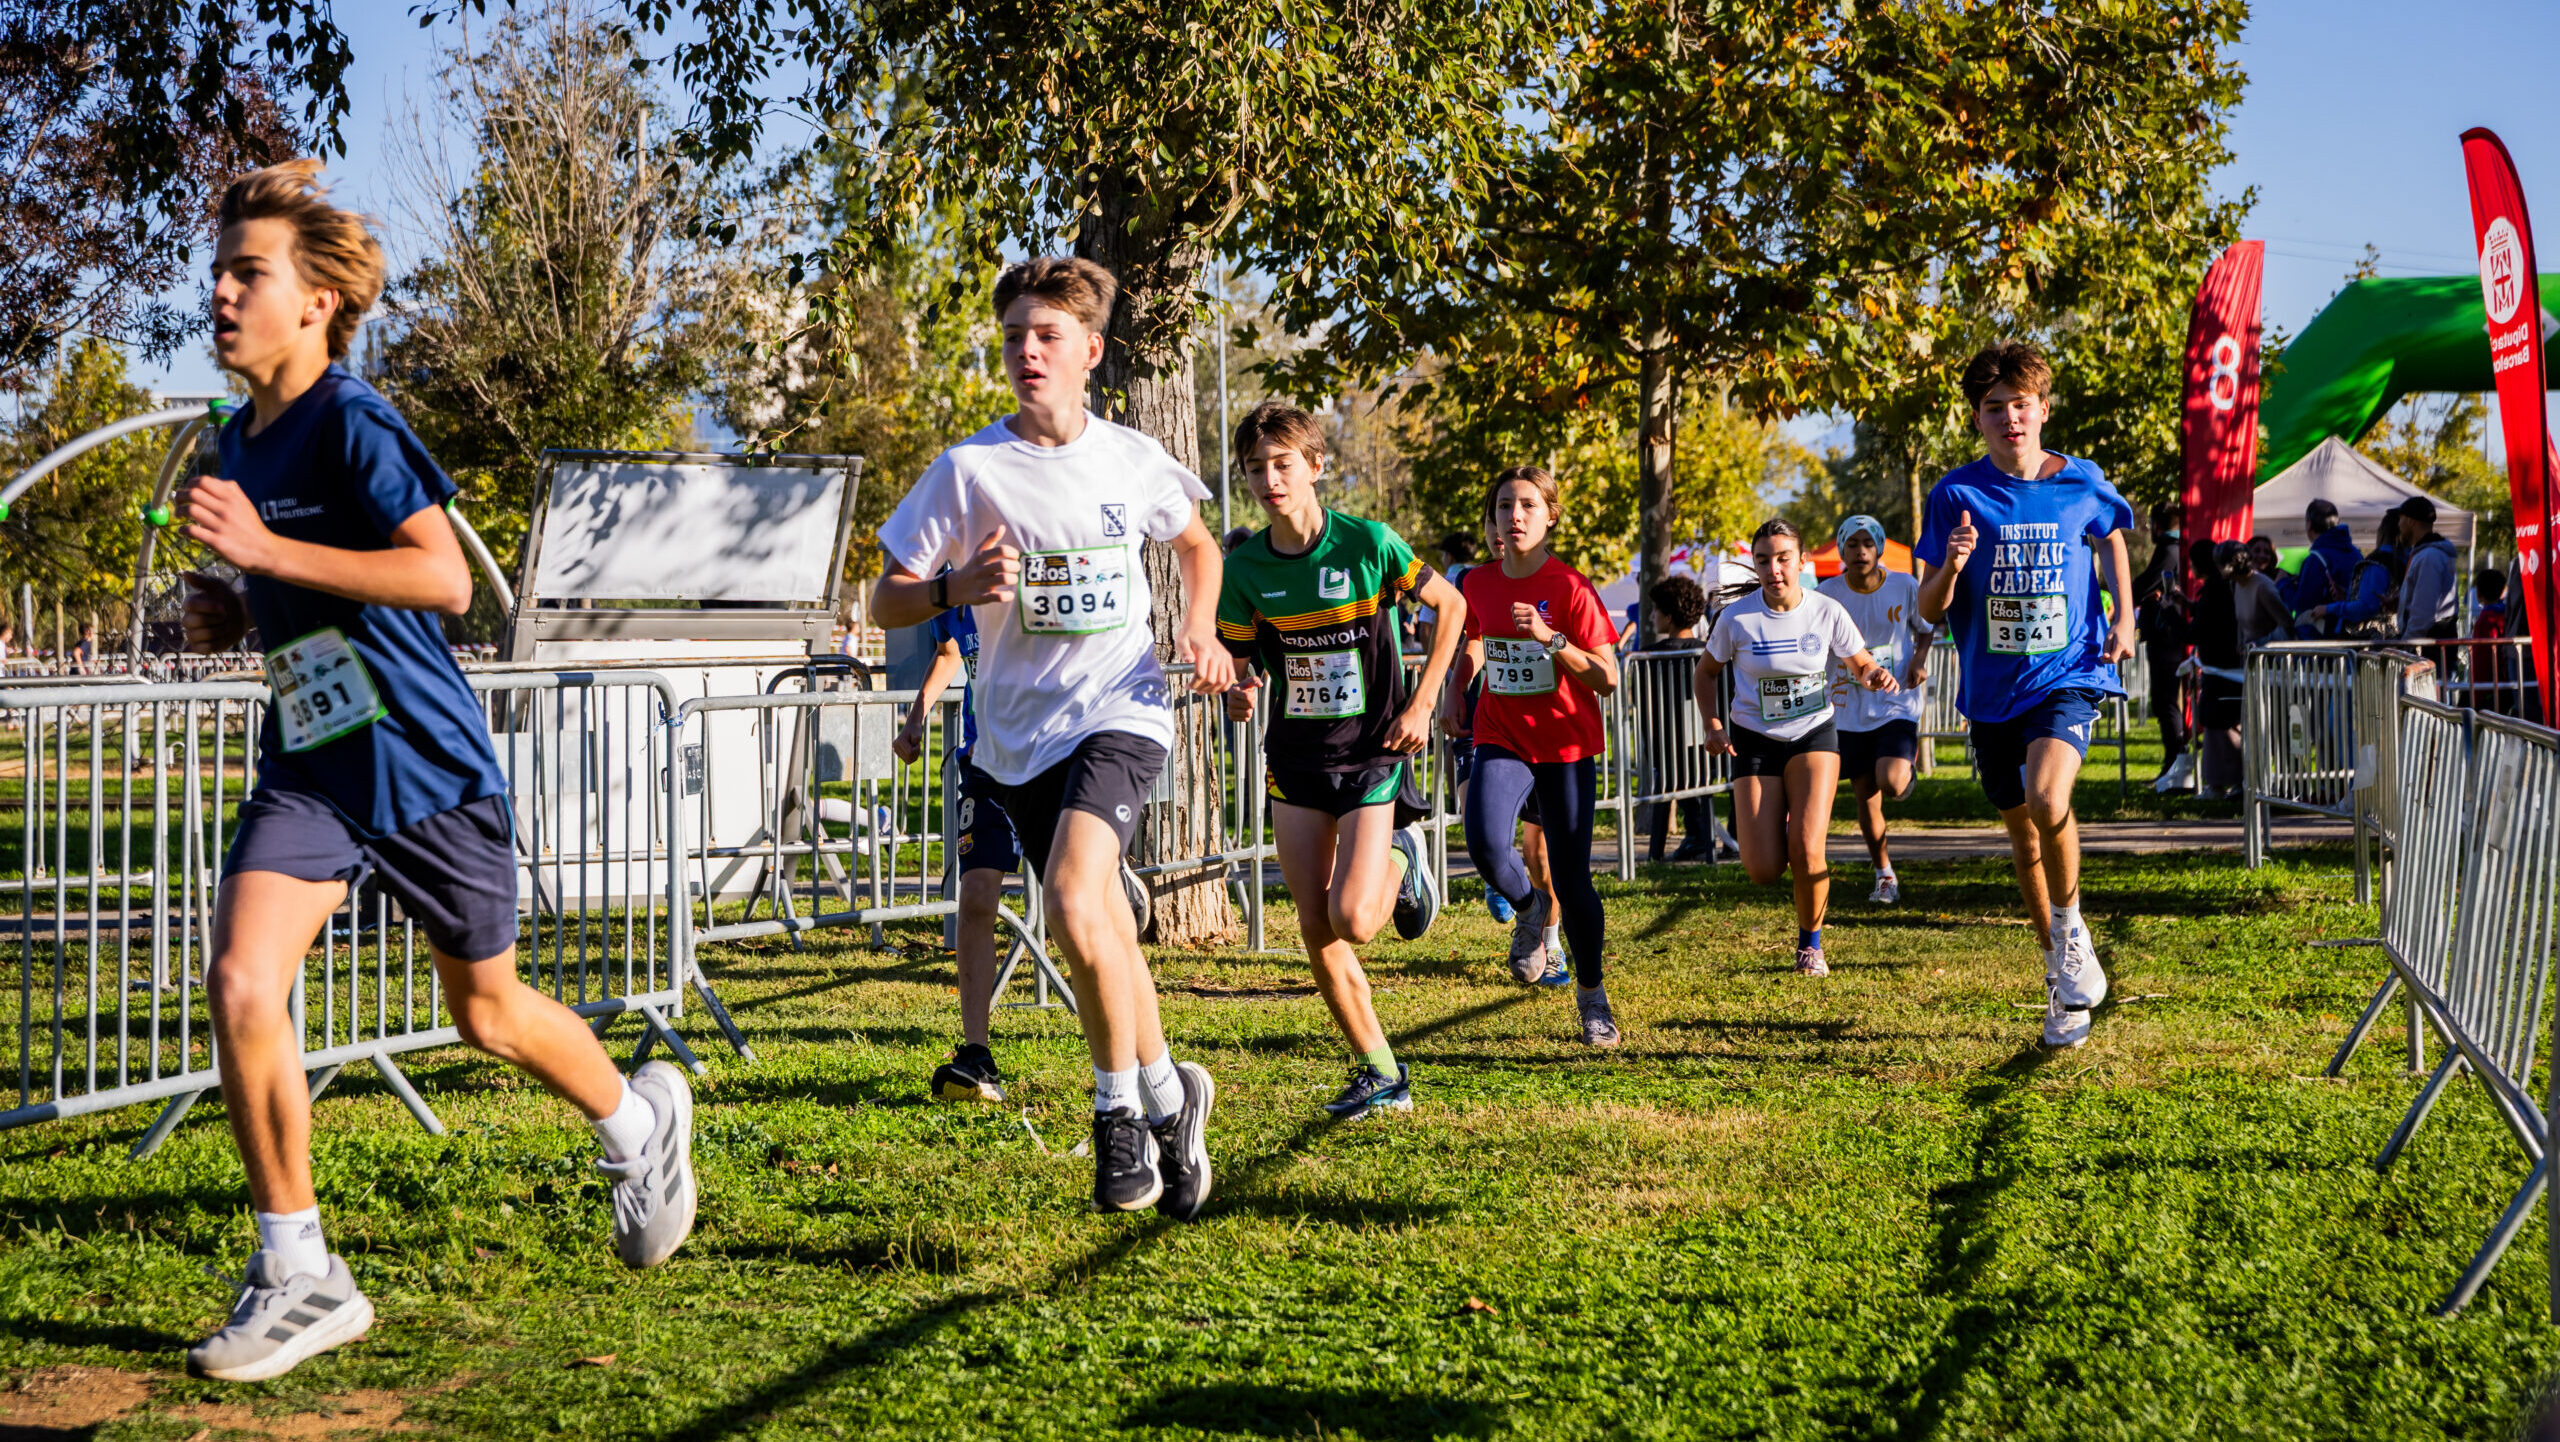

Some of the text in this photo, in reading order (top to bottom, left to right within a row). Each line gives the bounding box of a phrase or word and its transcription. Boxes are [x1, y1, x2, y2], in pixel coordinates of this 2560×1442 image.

[2000, 523, 2059, 540] INSTITUT
[1993, 543, 2065, 568] ARNAU
[1990, 568, 2064, 594] CADELL
[1033, 591, 1116, 616] 3094
[1993, 609, 2020, 618] CROS
[2000, 624, 2053, 642] 3641
[1290, 666, 1311, 677] CROS
[1497, 668, 1534, 683] 799
[1296, 685, 1348, 704] 2764
[960, 797, 976, 830] 8
